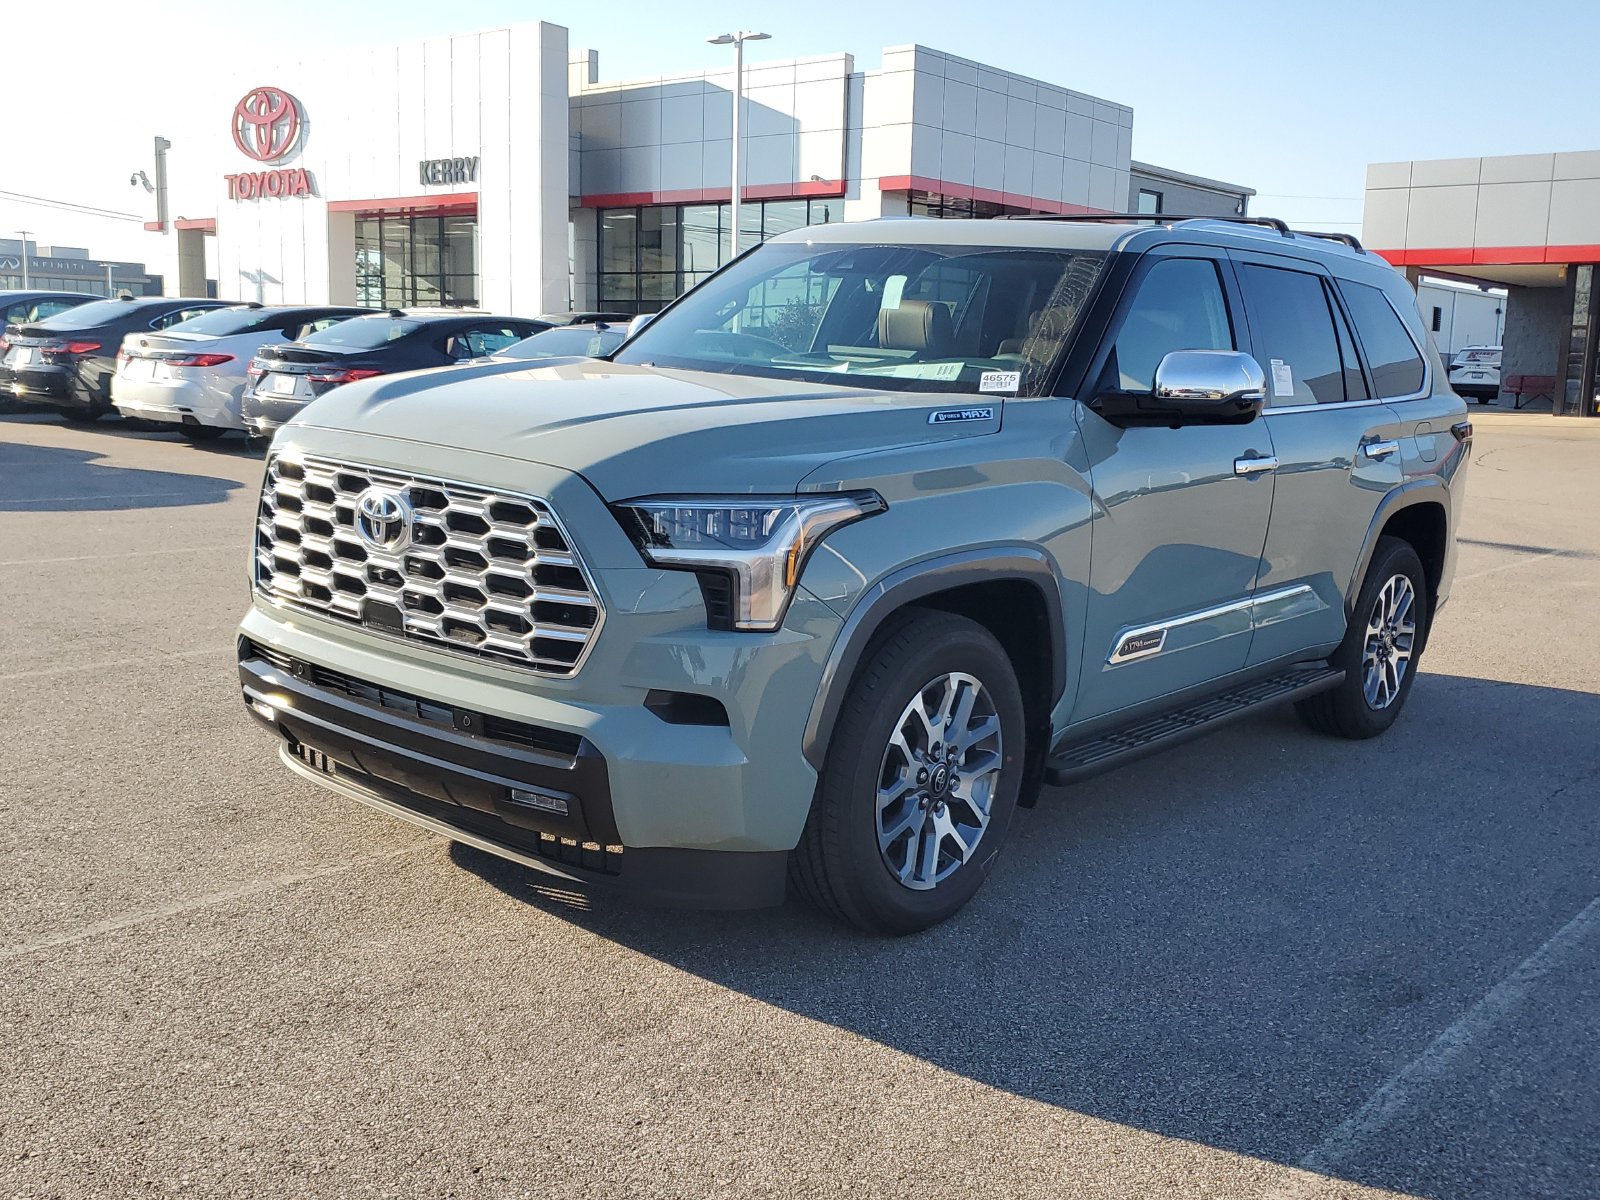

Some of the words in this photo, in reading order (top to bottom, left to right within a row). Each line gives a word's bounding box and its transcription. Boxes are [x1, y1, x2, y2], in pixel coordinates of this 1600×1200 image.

[419, 156, 480, 186] KERRY
[224, 168, 311, 200] TOYOTA
[25, 259, 85, 272] NFINITI
[982, 374, 1017, 382] 46575
[961, 410, 990, 419] MAX
